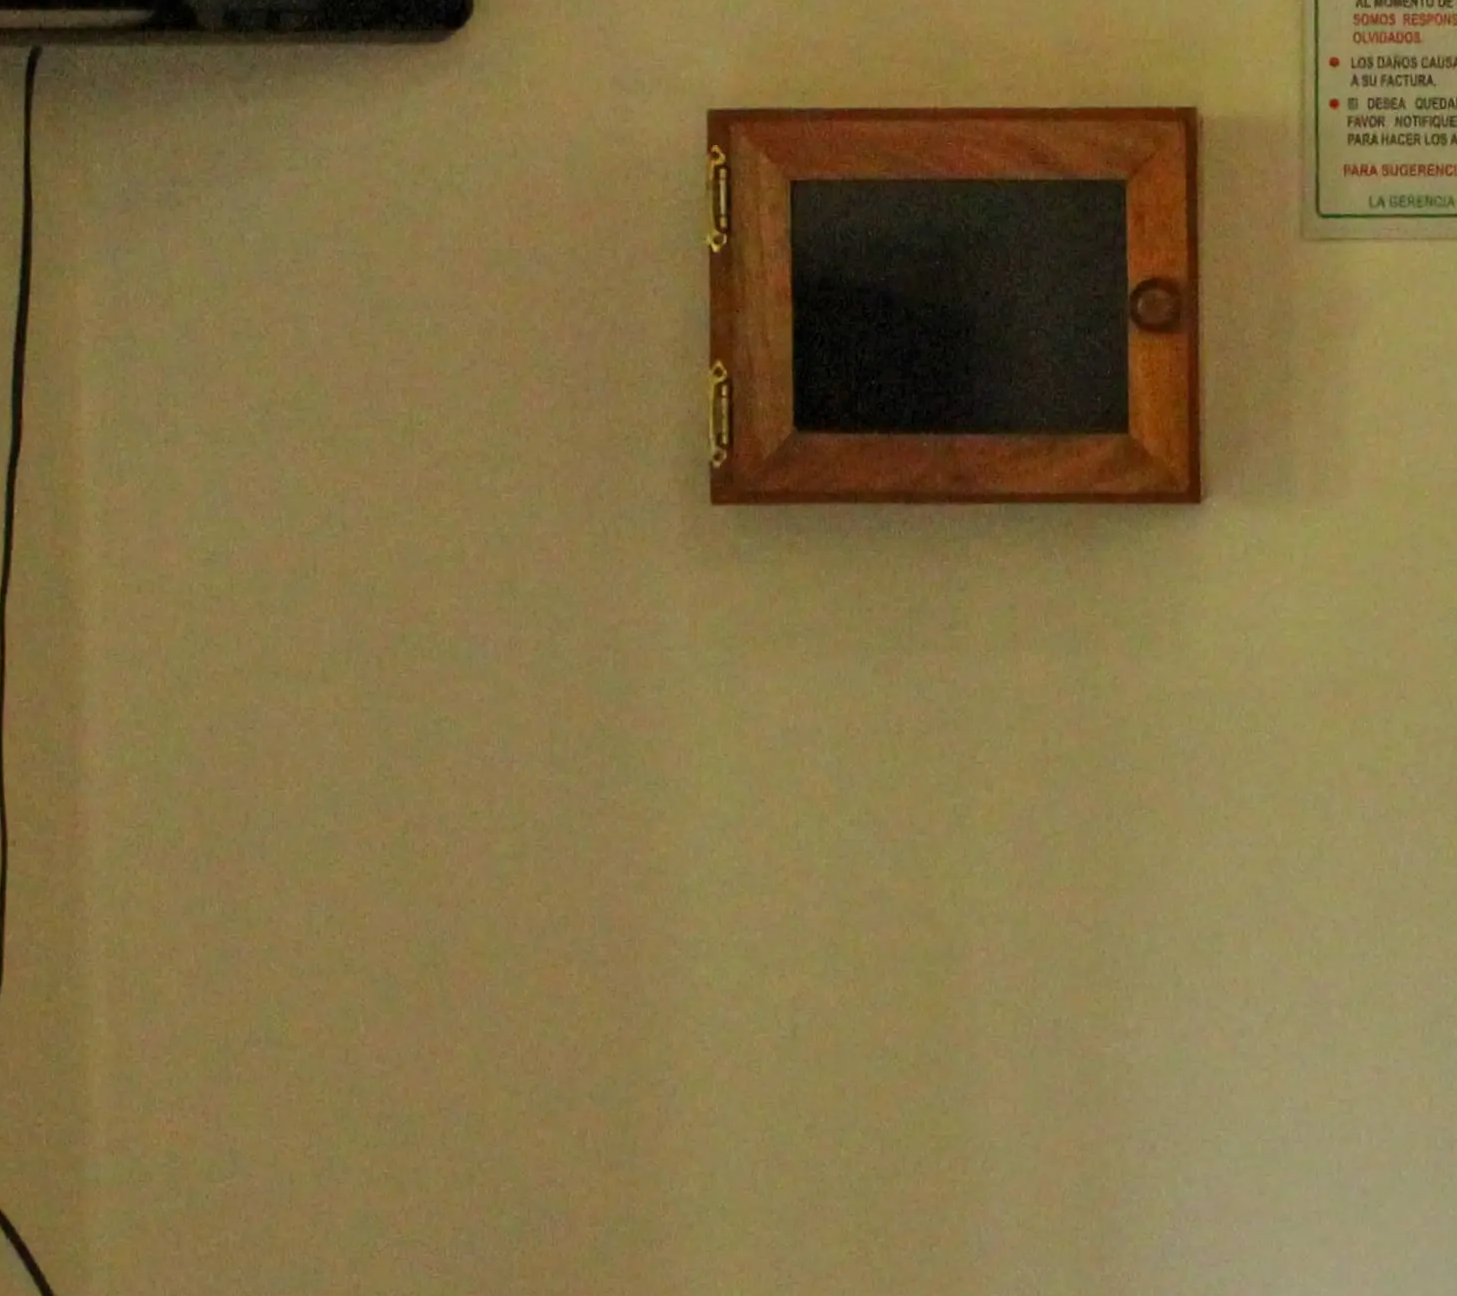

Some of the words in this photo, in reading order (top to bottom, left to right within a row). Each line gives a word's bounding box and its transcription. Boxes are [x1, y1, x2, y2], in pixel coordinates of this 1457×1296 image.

[1353, 13, 1396, 26] SOMOS
[1350, 56, 1374, 69] LOS
[1350, 74, 1359, 87] A
[1361, 74, 1377, 87] SU
[1367, 97, 1406, 110] DESEA
[1347, 115, 1385, 128] FAVOR
[1347, 133, 1379, 146] PARA
[1381, 133, 1421, 146] HACER
[1424, 133, 1447, 146] LOS
[1343, 163, 1378, 177] PARA
[1369, 195, 1385, 208] LA
[1388, 195, 1455, 208] GERENCIA
